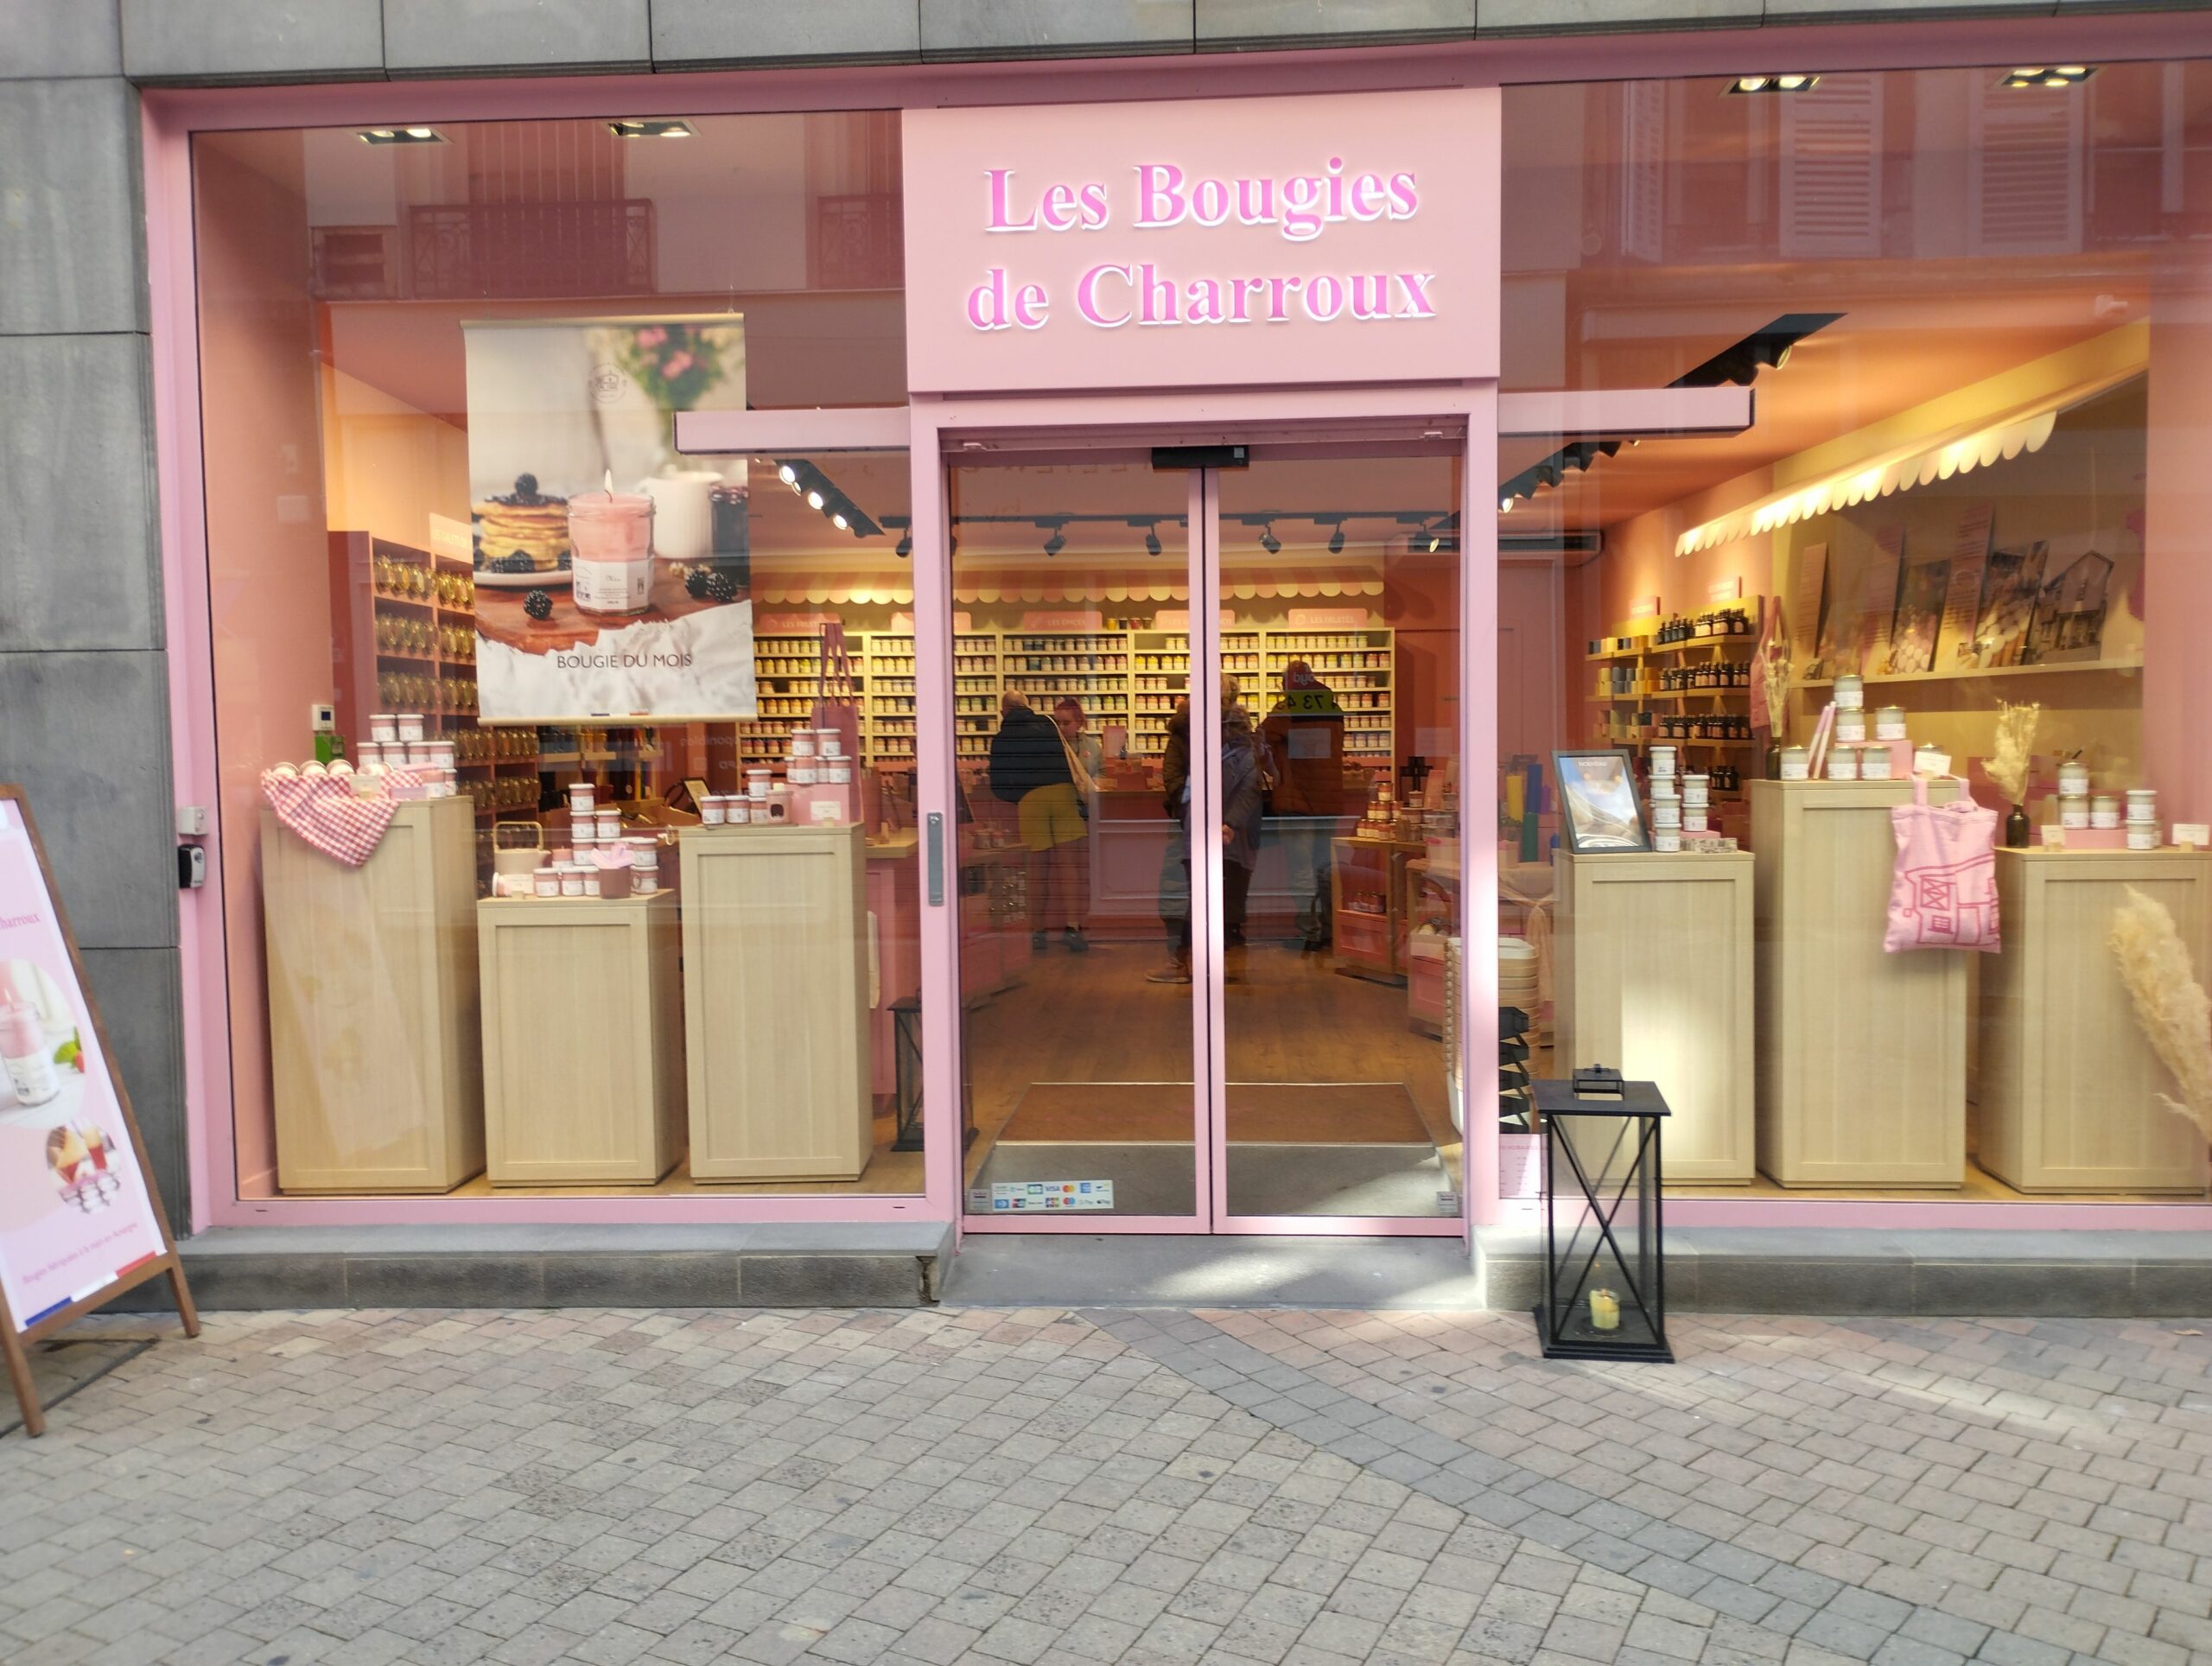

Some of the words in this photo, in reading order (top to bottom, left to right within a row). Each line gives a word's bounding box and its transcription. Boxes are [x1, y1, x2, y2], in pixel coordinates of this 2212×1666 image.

[984, 168, 1109, 233] Les
[1133, 156, 1420, 242] Bougies
[968, 268, 1049, 332] de
[1077, 262, 1437, 328] Charroux
[556, 653, 619, 669] BOUGIE
[622, 653, 648, 668] DU
[654, 652, 693, 668] MOIS
[0, 914, 41, 928] harroux
